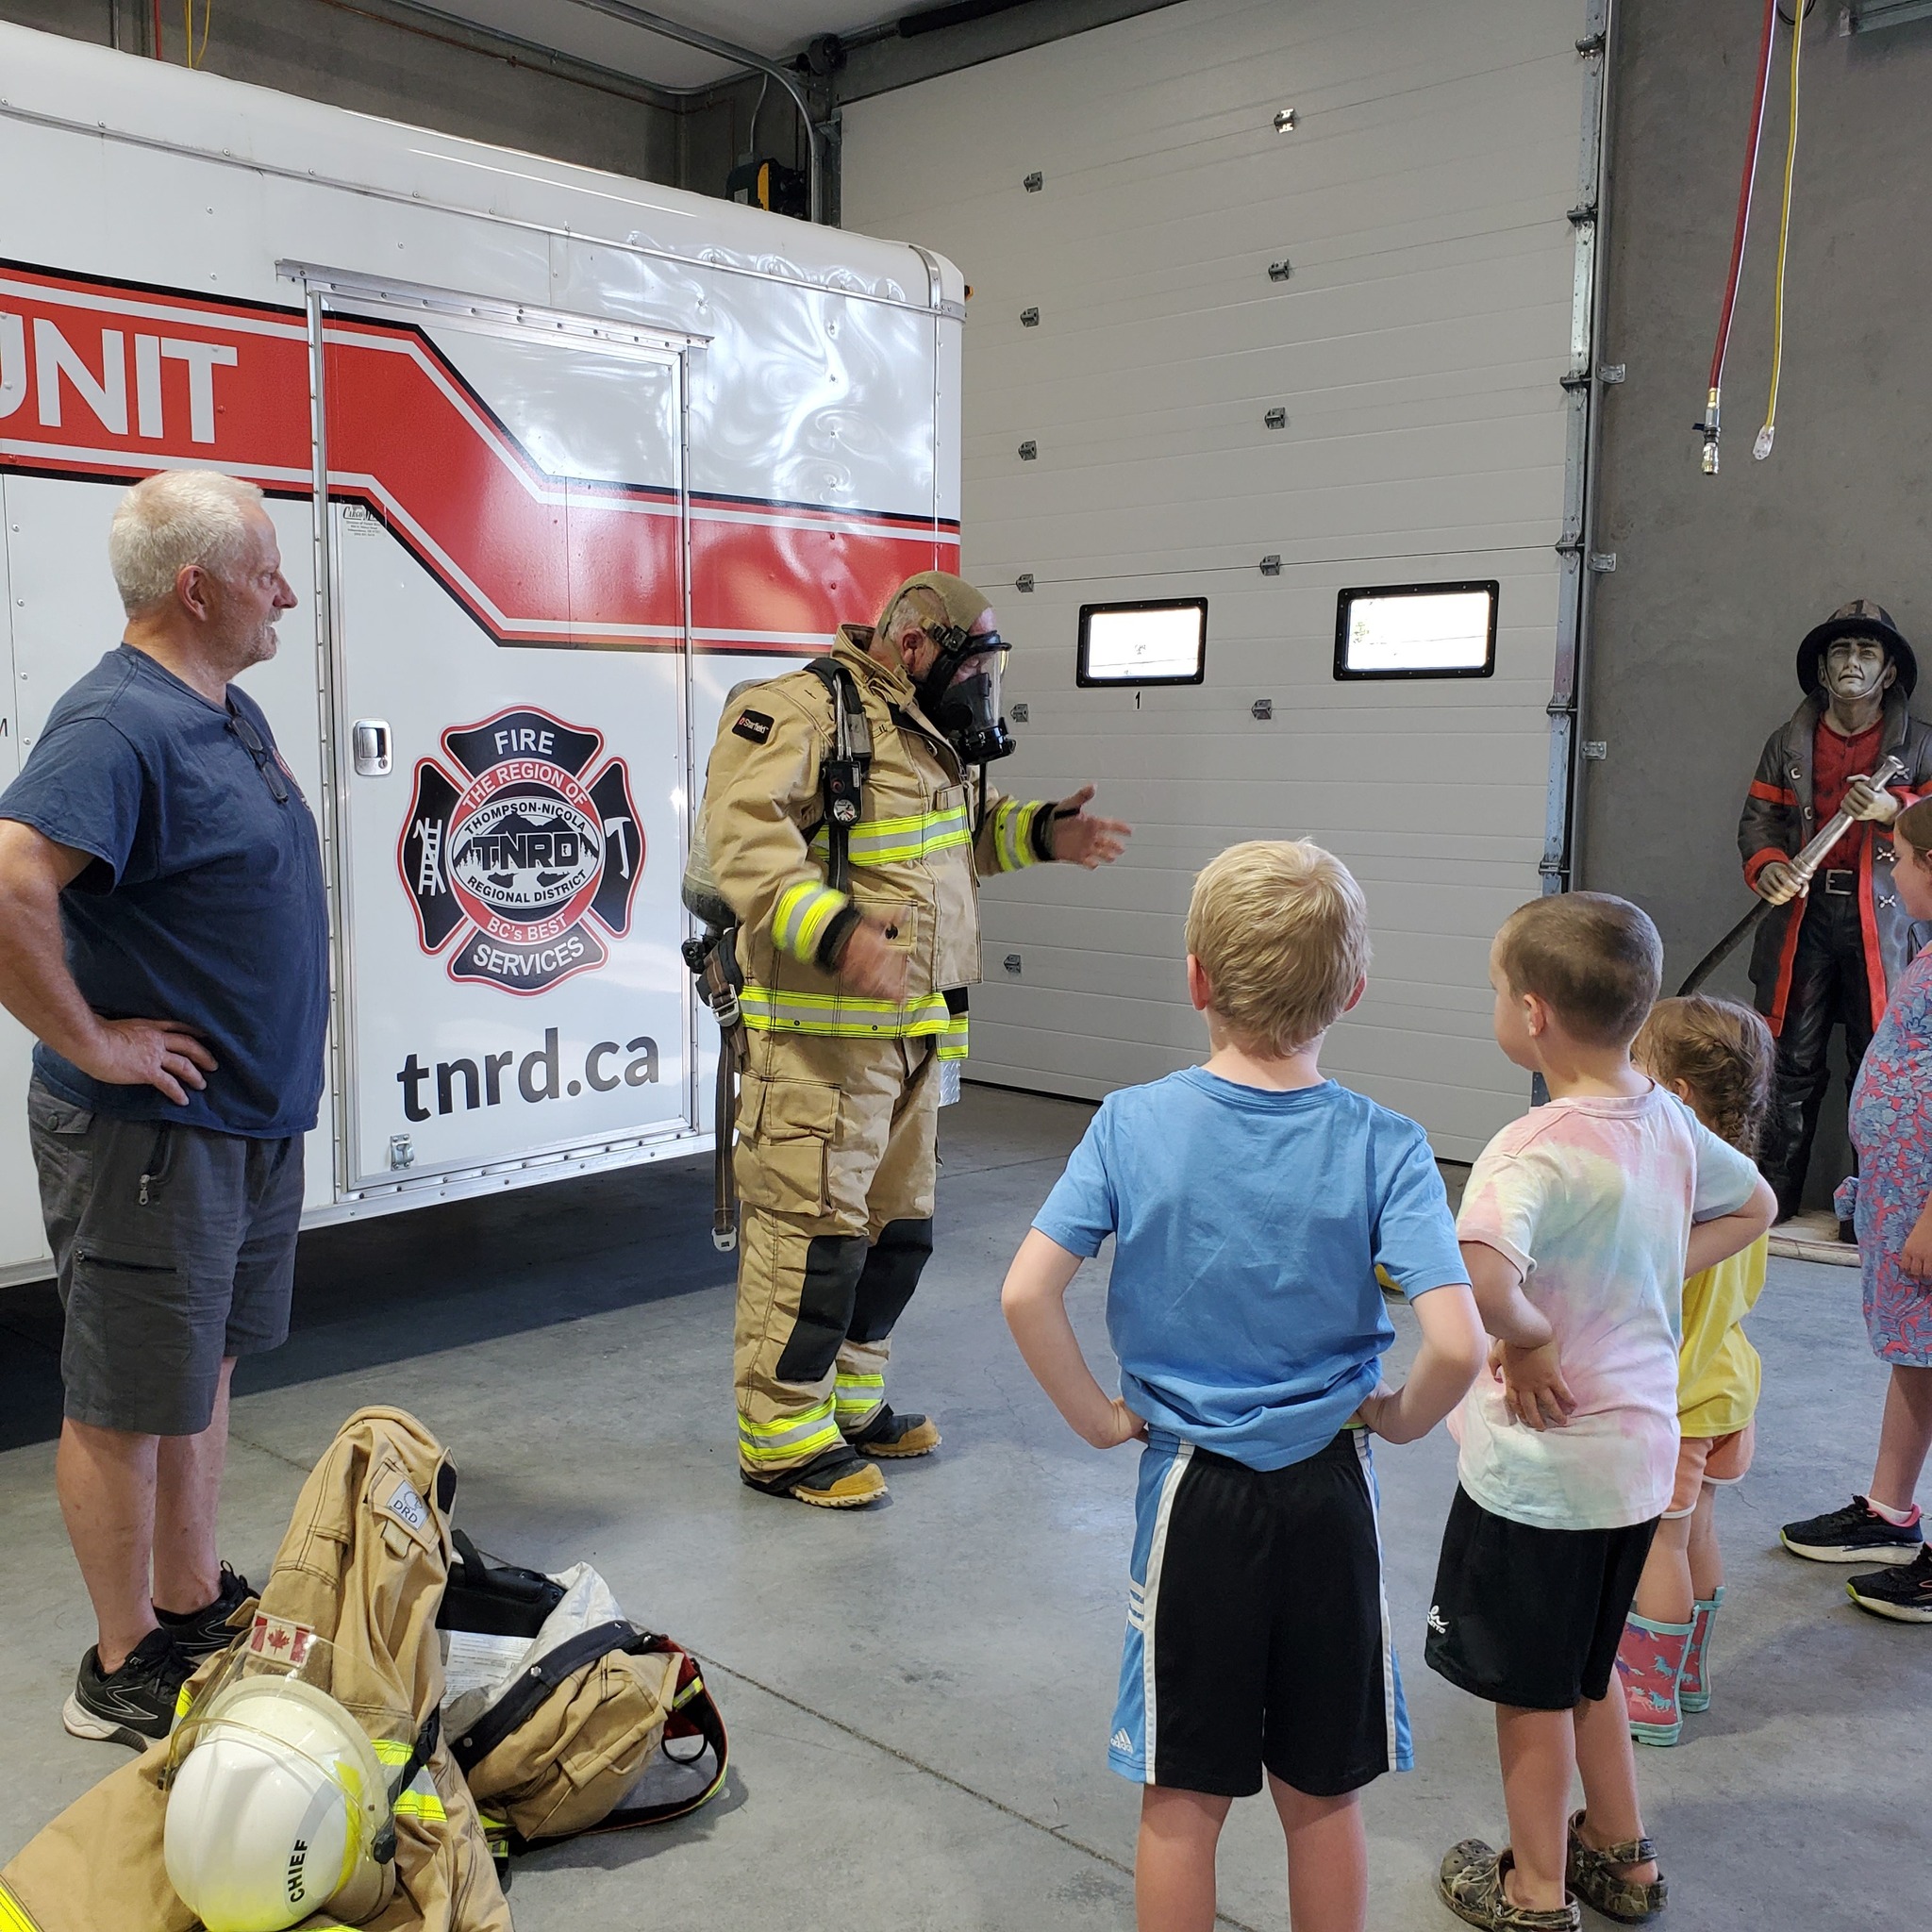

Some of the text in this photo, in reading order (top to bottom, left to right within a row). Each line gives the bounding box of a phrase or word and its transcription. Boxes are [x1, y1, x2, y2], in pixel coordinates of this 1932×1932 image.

[1135, 691, 1141, 709] 1
[493, 728, 555, 755] FIRE
[461, 762, 588, 810] THE REGION OF
[464, 802, 586, 836] THOMPSON-NICOLA
[472, 830, 583, 872] TNRD
[467, 869, 587, 904] REGIONAL DISTRICT
[487, 913, 568, 941] BC's BEST
[473, 936, 585, 976] SERVICES
[396, 1026, 659, 1123] tnrd.ca
[392, 1499, 418, 1524] DRD
[288, 1839, 308, 1903] CHIEF
